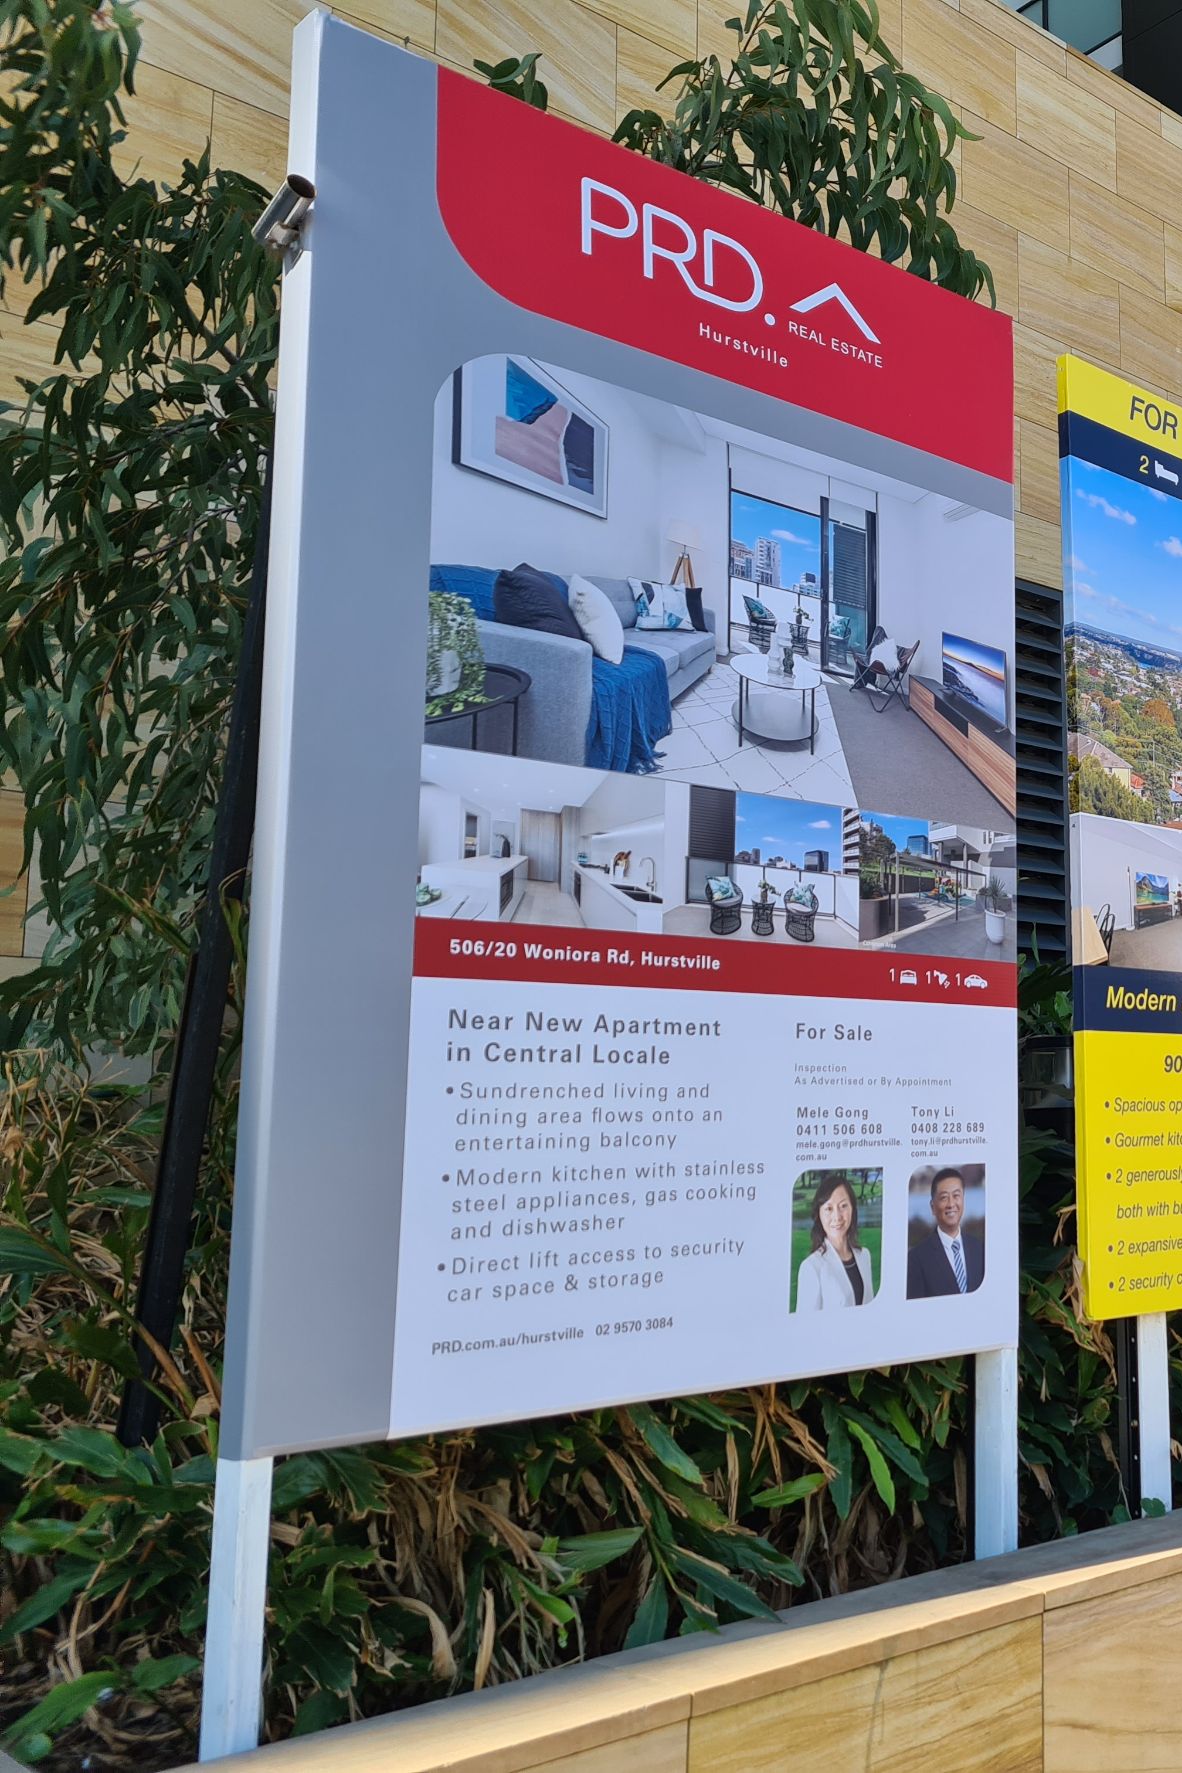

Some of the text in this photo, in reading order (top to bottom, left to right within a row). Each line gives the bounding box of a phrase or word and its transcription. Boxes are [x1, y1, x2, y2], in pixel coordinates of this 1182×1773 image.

[580, 177, 776, 326] PRD.
[699, 322, 789, 368] Hurstville
[789, 321, 883, 369] REAL ESTATE
[1130, 395, 1178, 440] FOR
[1139, 455, 1149, 474] 2
[450, 939, 721, 971] 506/20 Woniora Rd, Hurstville
[889, 968, 960, 986] 1 1 1
[1106, 986, 1177, 1011] Modern
[448, 1009, 722, 1038] Near New Apartment
[796, 1022, 873, 1041] For Sale
[448, 1042, 670, 1064] in Central Locale
[794, 1064, 847, 1073] Inspection
[460, 1082, 710, 1102] Sundrenched living and
[794, 1077, 806, 1085] As
[811, 1077, 863, 1085] Advertised
[881, 1077, 891, 1087] By
[895, 1077, 951, 1087] Appointment
[797, 1107, 869, 1120] Mele Gong
[912, 1106, 954, 1119] Tony Li
[1114, 1098, 1166, 1115] Spacious
[456, 1107, 722, 1129] dining area flows onto an
[911, 1122, 985, 1133] 0408 228 689
[797, 1124, 882, 1135] 0411 506 608
[455, 1132, 677, 1152] entertaining balcony
[1115, 1133, 1164, 1148] Gourmet
[796, 1153, 827, 1161] com.au
[456, 1160, 765, 1186] Modern kitchen with stainless
[1115, 1169, 1123, 1184] 2
[452, 1184, 756, 1213] steel appliances, gas cooking
[1117, 1205, 1142, 1220] both
[1147, 1203, 1170, 1218] with
[451, 1215, 625, 1240] and dishwasher
[452, 1239, 744, 1275] Direct lift access to security
[1117, 1241, 1124, 1255] 2
[448, 1270, 664, 1302] car space & storage
[1118, 1277, 1125, 1291] 2
[1129, 1273, 1174, 1293] security
[595, 1317, 673, 1336] 02 9570 3084
[432, 1327, 584, 1355] PRD.com.au/hurstville
